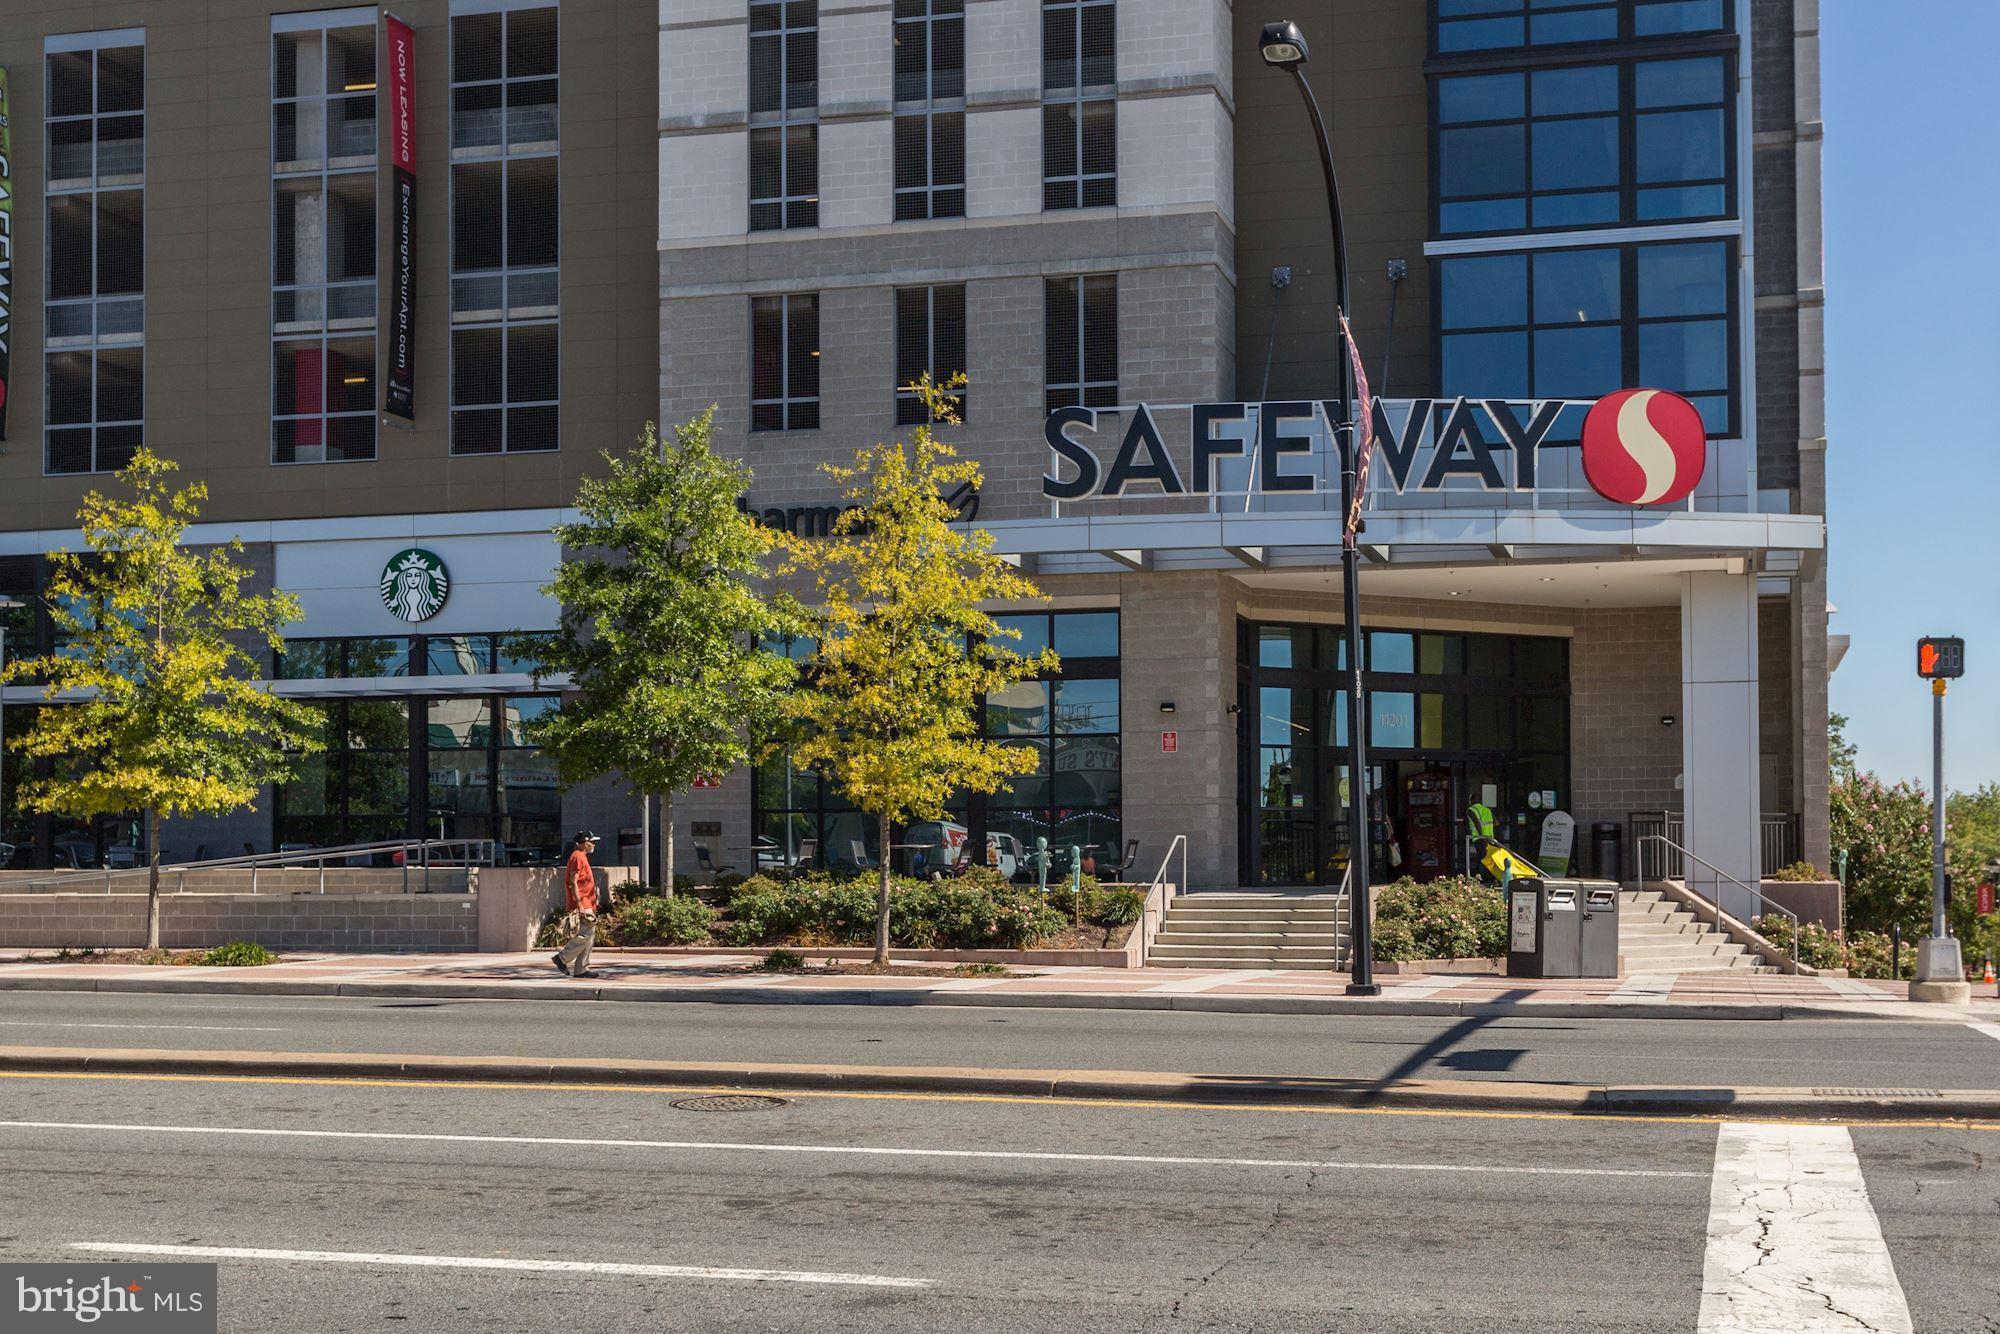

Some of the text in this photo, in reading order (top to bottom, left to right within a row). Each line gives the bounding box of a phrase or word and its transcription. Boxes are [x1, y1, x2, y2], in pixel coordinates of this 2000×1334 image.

[397, 39, 409, 162] NOW LEASING
[1043, 396, 1565, 502] SAFEWAY
[736, 496, 880, 538] harma
[1380, 712, 1408, 729] 11201
